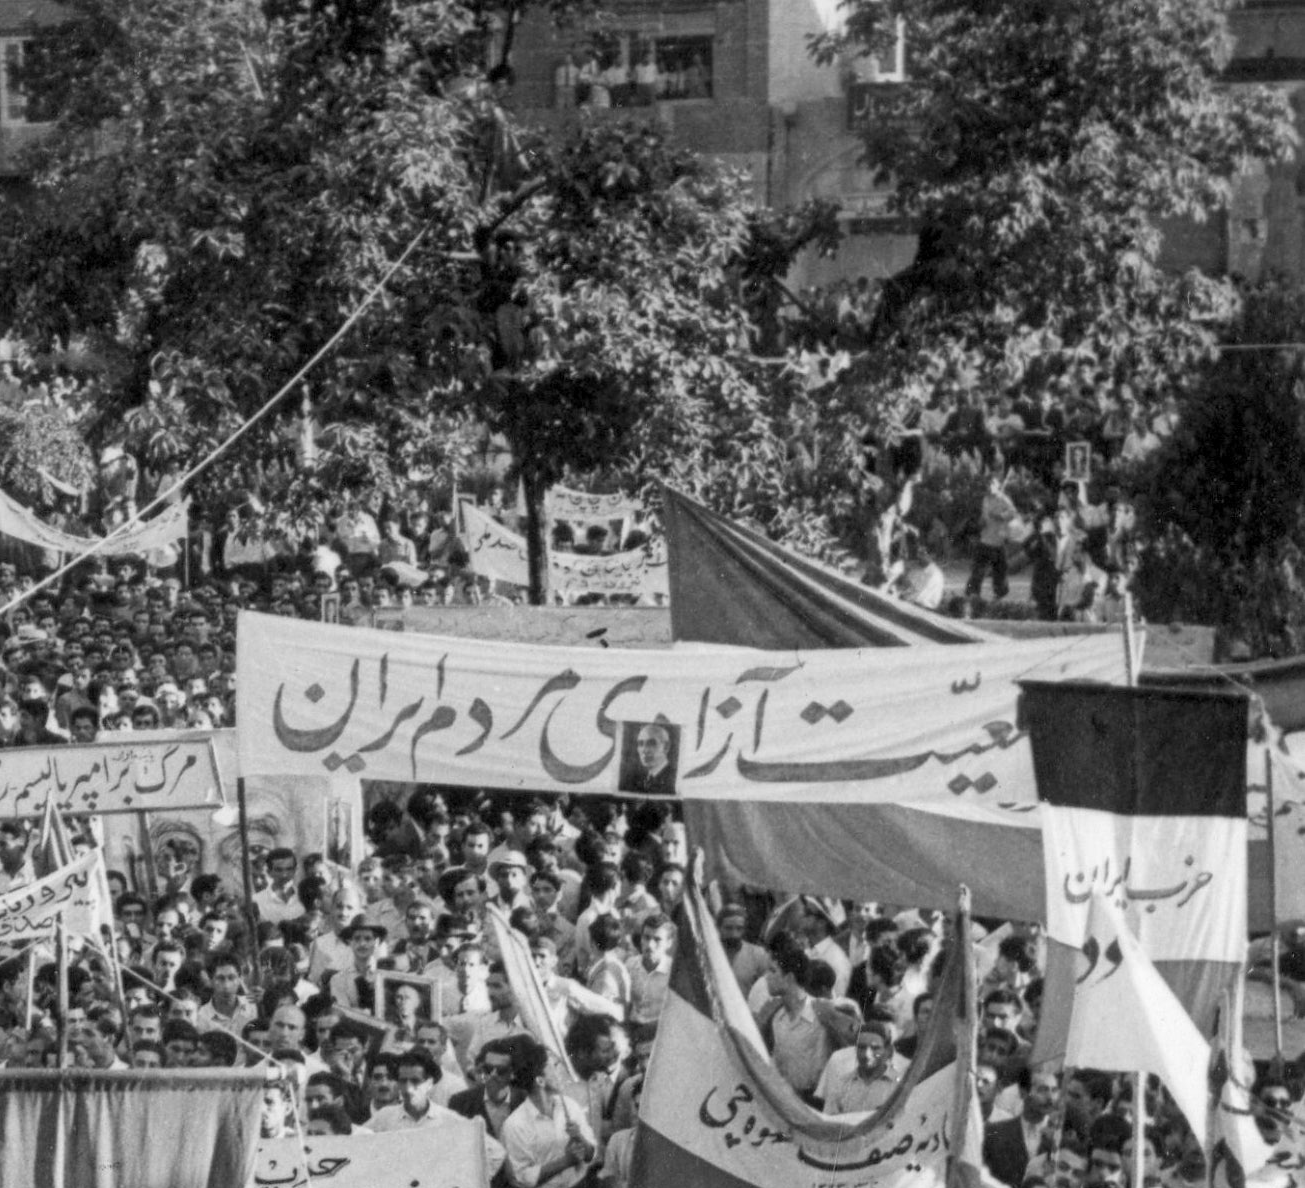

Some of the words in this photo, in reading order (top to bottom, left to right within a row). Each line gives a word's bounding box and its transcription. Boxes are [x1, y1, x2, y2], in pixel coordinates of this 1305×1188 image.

[273, 651, 448, 774] ایران
[411, 667, 584, 780] مردم
[540, 661, 806, 785] آزای
[108, 760, 132, 808] بر
[1124, 854, 1214, 914] حزب
